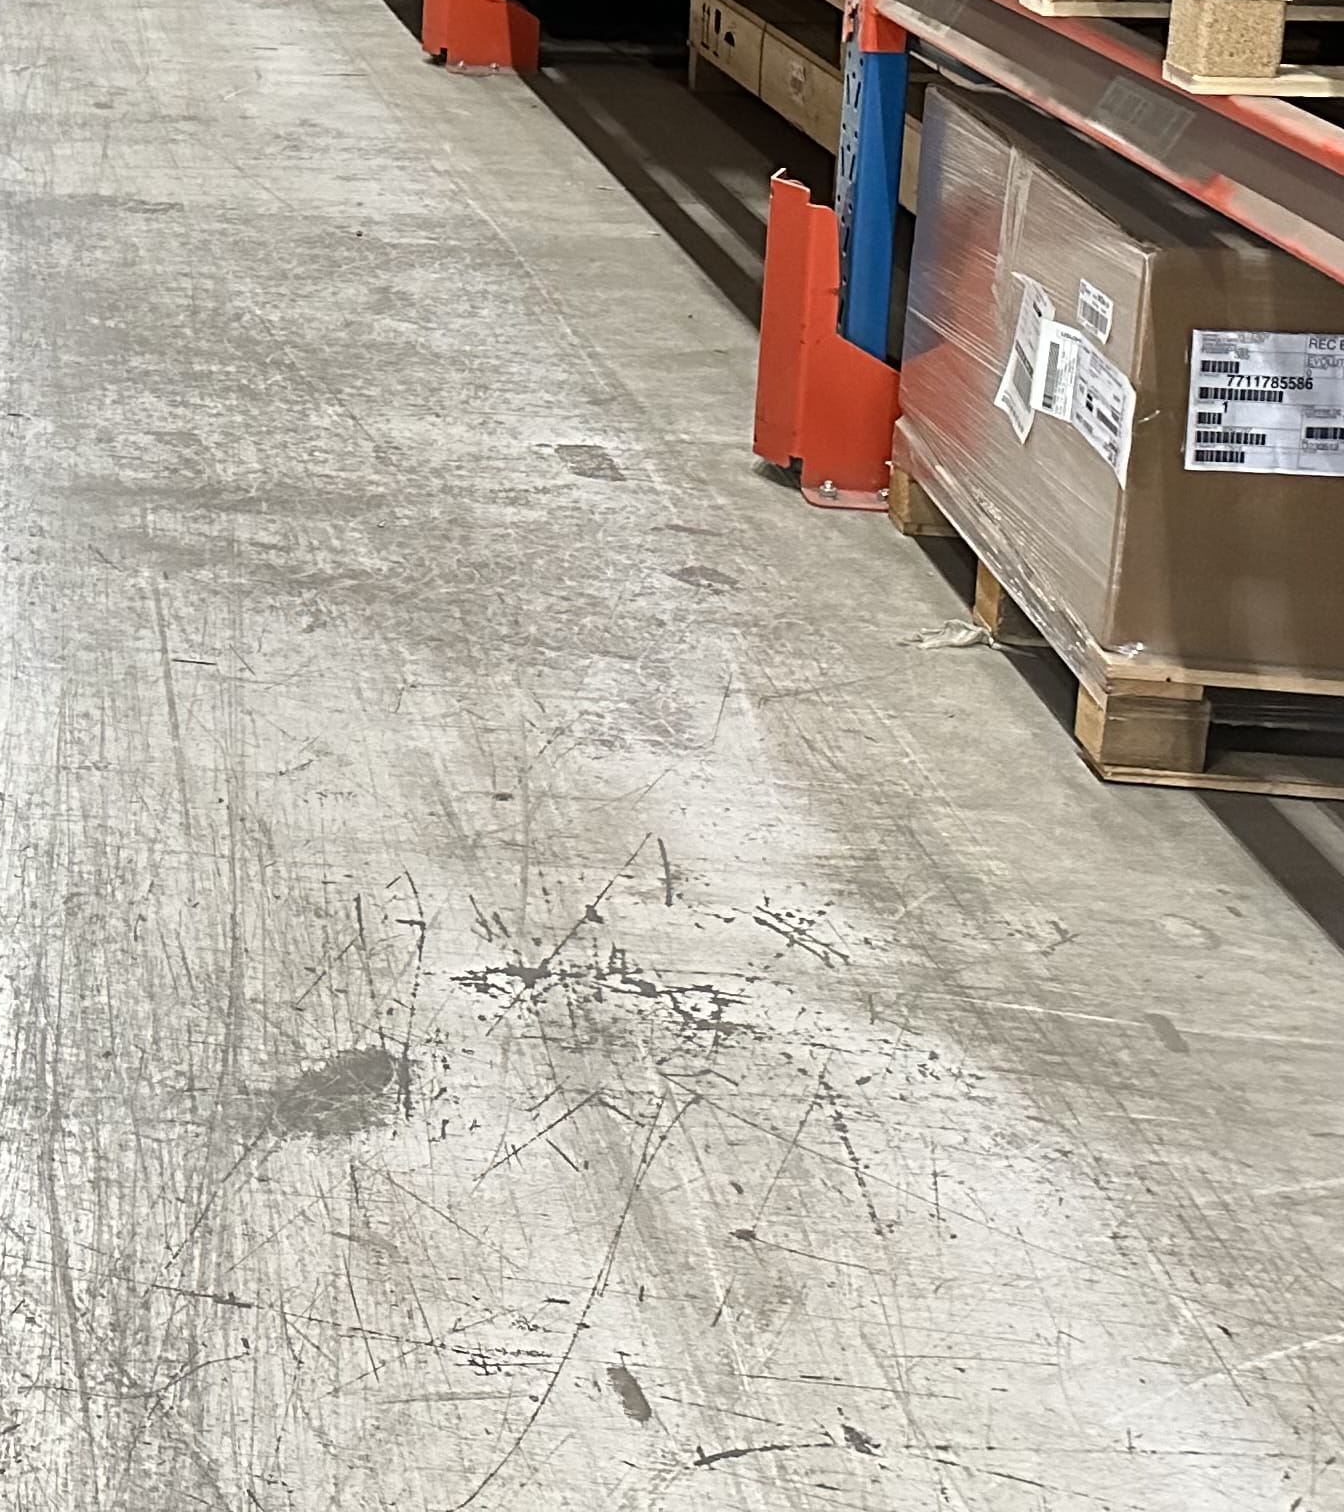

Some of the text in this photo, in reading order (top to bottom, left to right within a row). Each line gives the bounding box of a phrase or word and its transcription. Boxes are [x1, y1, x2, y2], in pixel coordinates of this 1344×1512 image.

[1308, 338, 1336, 350] REC
[1226, 374, 1314, 390] 7711785586
[1222, 401, 1229, 414] 1
